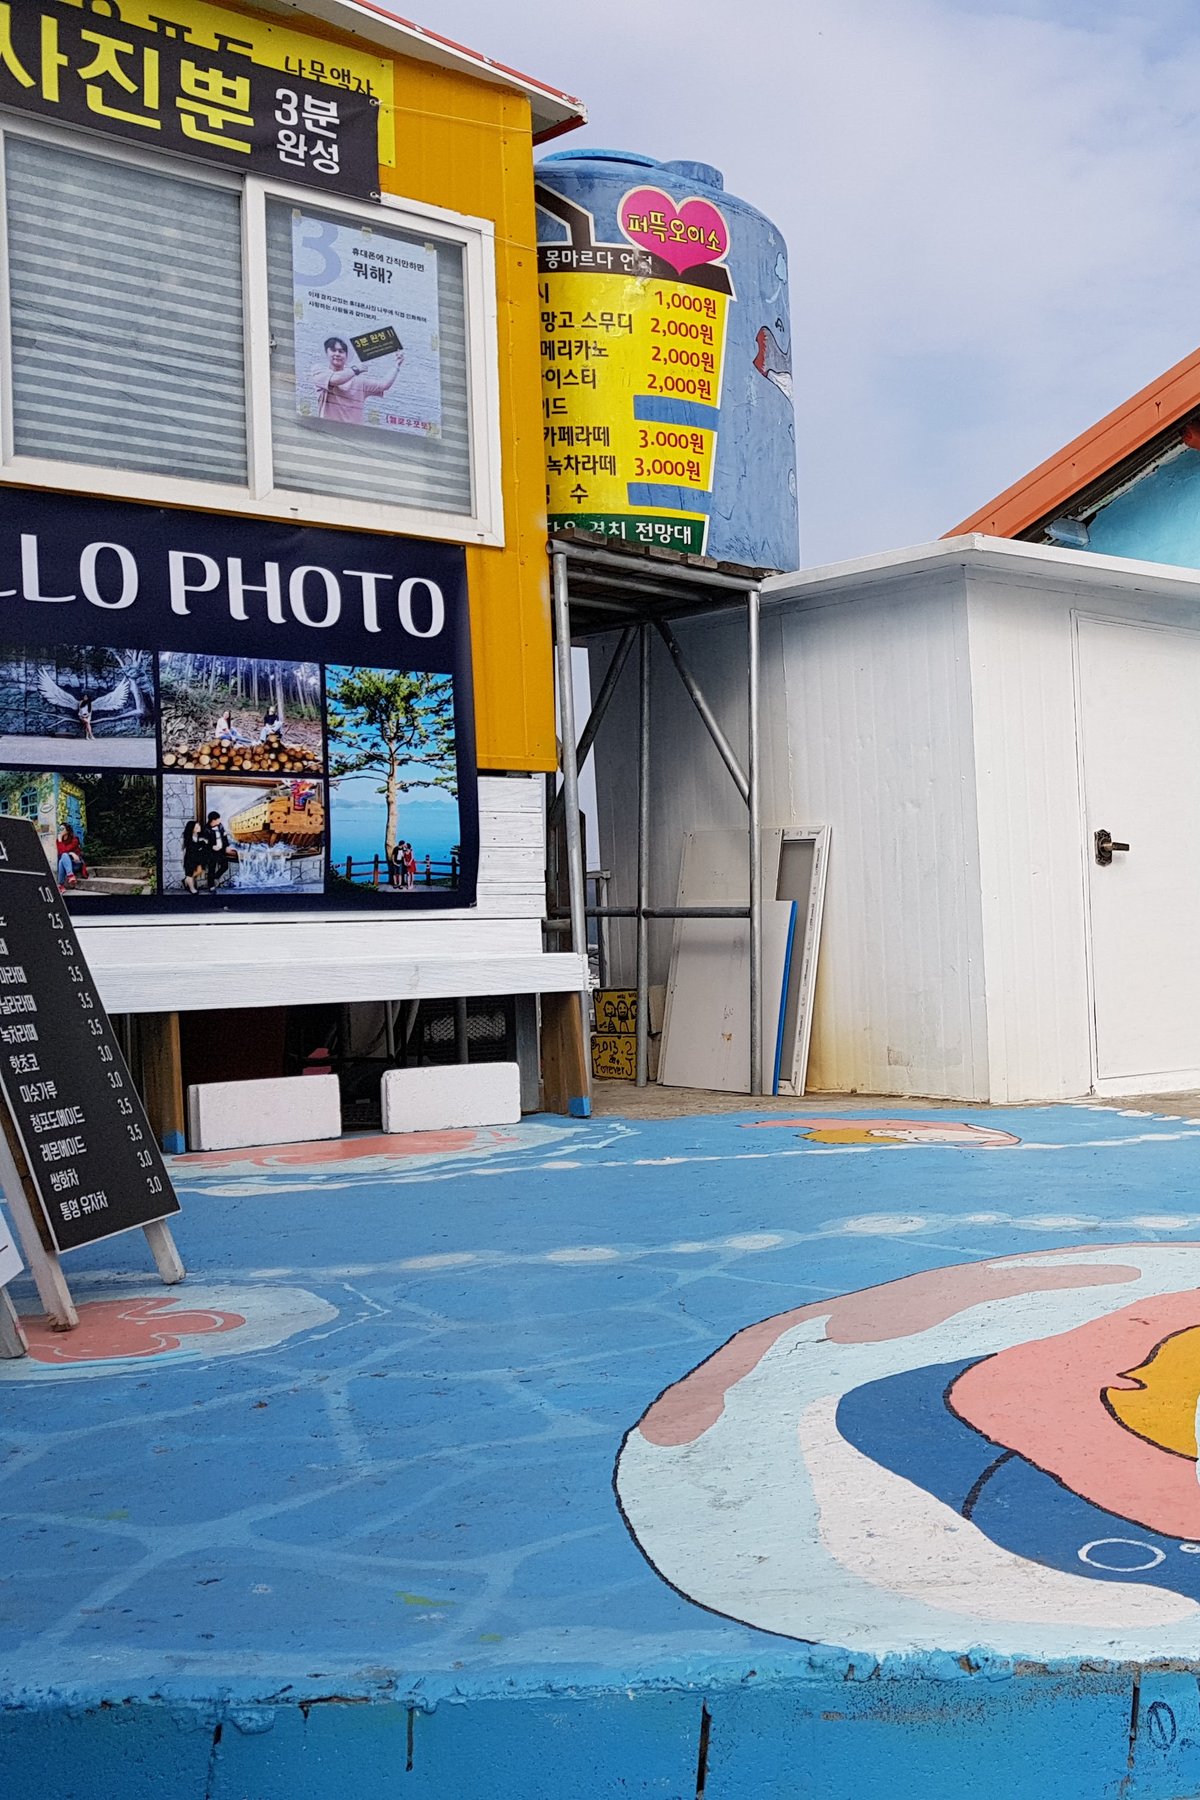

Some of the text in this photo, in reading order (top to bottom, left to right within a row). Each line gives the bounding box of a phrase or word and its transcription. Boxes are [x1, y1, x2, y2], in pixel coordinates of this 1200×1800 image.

[274, 88, 340, 140] 3분
[276, 129, 340, 175] 완성
[352, 261, 393, 285] 뭐해?
[545, 250, 614, 270] 몽마르다
[655, 291, 717, 319] 1,000원
[541, 311, 714, 346] 망고 스무디 2,000원
[651, 346, 715, 374] 2,000원
[542, 368, 712, 401] 이스티 2,000원
[639, 429, 704, 455] 3.000원
[546, 455, 701, 482] 녹차라떼 3,000원
[635, 522, 692, 545] 전망대
[0, 533, 445, 638] LO PHOTO
[38, 885, 54, 903] 1.0
[58, 939, 74, 956] 3.5
[68, 966, 84, 982] 3.5
[78, 992, 94, 1009] 3.5
[88, 1018, 103, 1035] 3.5
[9, 1045, 113, 1074] 핫초코 3.0
[19, 1071, 123, 1103] 미숫가루 3.0
[29, 1097, 133, 1134] 청포도에이드 3.5
[39, 1123, 143, 1162] 레몬에이드 3.5
[50, 1150, 153, 1192] 쌍화차 3.0
[59, 1176, 163, 1221] 통영 유자차 3.0
